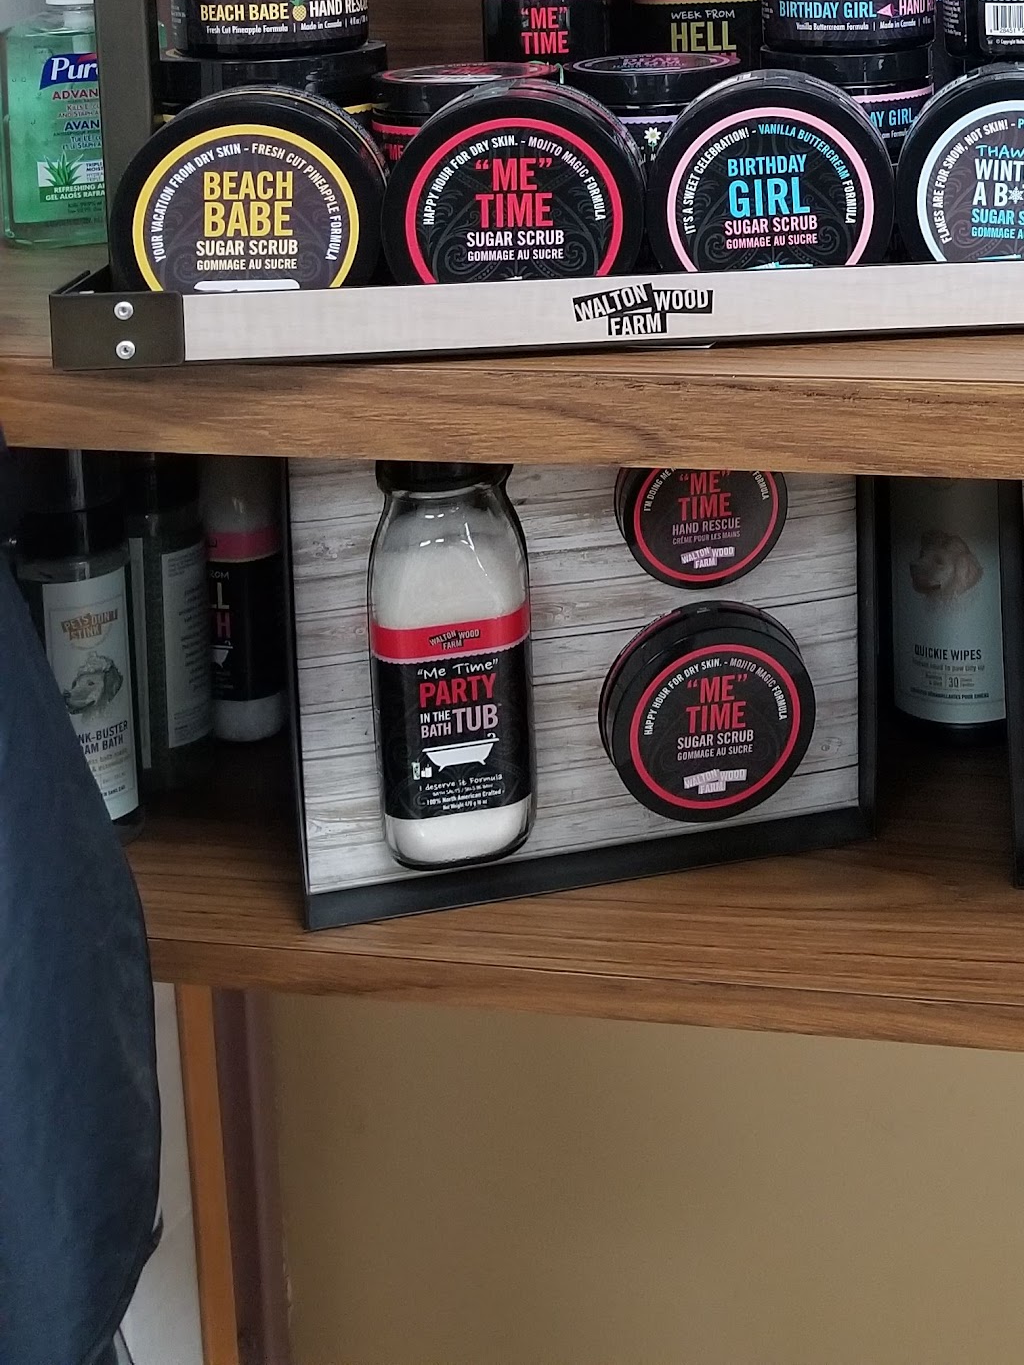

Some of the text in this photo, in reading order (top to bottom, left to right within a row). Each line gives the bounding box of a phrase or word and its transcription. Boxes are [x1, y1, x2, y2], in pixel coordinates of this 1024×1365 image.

[200, 5, 244, 21] BEACH
[249, 3, 289, 20] BABE
[671, 9, 735, 20] WEEK FROM
[779, 2, 839, 20] BIRTHDAY
[843, 1, 877, 19] GIRL
[521, 31, 569, 54] TIME
[670, 21, 737, 52] HELL
[727, 154, 807, 177] BIRTHDAY
[203, 171, 293, 200] BEACH
[973, 184, 987, 206] A
[728, 176, 810, 218] GIRL
[204, 201, 293, 238] BABE
[475, 193, 553, 229] TIME
[971, 208, 1015, 225] SUGAR
[724, 215, 818, 235] SUGAR SCRUB
[196, 239, 299, 256] SUGAR SCRUB
[466, 230, 564, 247] SUGAR SCRUB
[197, 259, 297, 271] GOMMAGE AU SUCRE
[575, 284, 708, 320] WALTON WOOD
[610, 314, 661, 335] FARM
[678, 493, 732, 521] TIME
[672, 517, 741, 536] HAND RESCUE
[914, 644, 982, 661] QUICKIE WIPES
[419, 673, 497, 708] PARTY
[420, 704, 499, 734] IN THE TUB
[686, 701, 747, 734] TIME
[421, 722, 451, 738] BATH
[677, 730, 754, 750] SUGAR SCRUB
